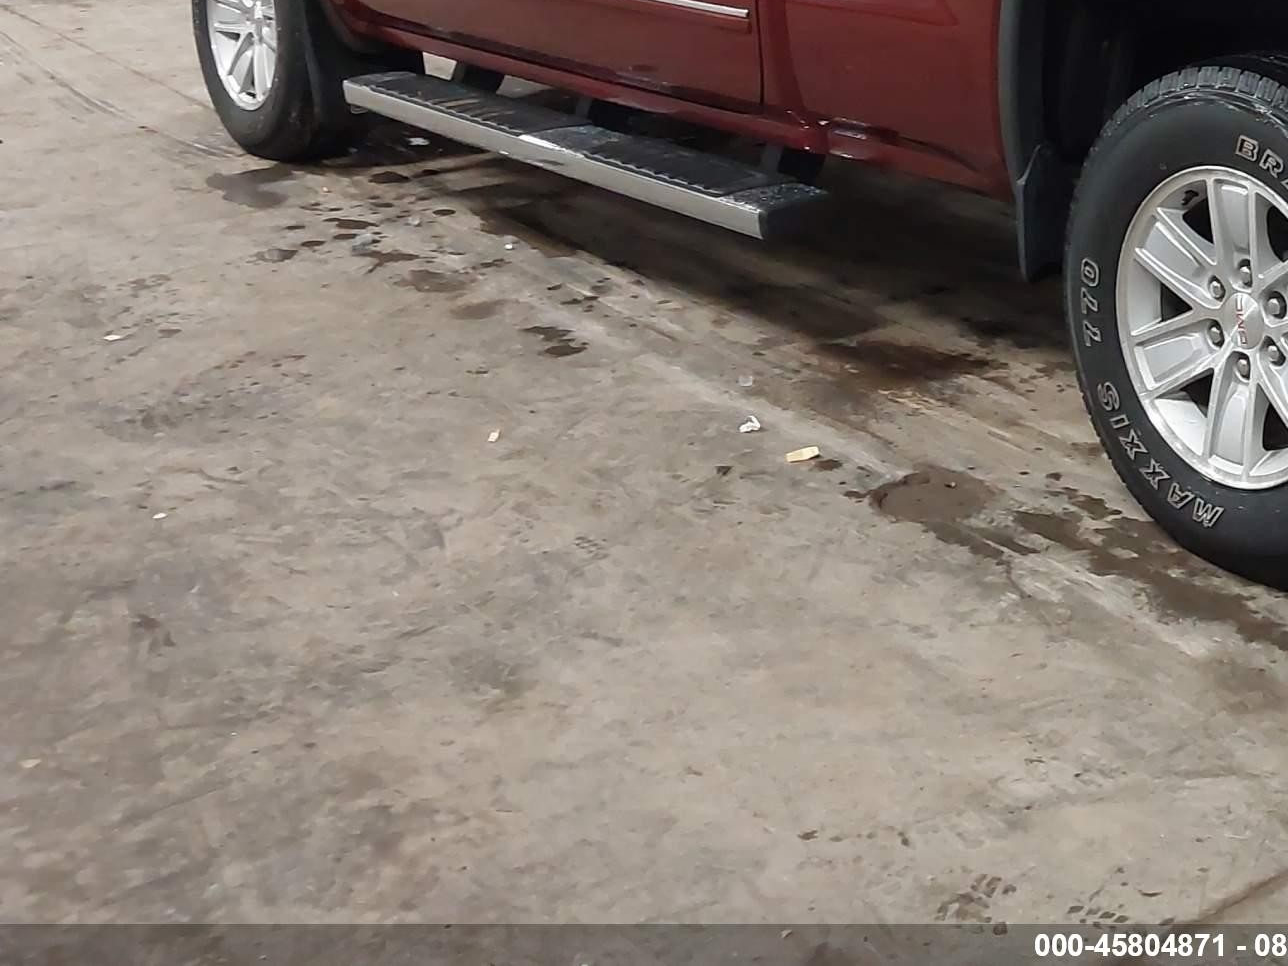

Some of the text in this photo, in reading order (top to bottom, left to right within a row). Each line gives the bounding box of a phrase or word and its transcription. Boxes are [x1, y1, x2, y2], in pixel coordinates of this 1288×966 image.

[1080, 257, 1224, 528] MAXXIS 770
[1235, 295, 1247, 345] GMC
